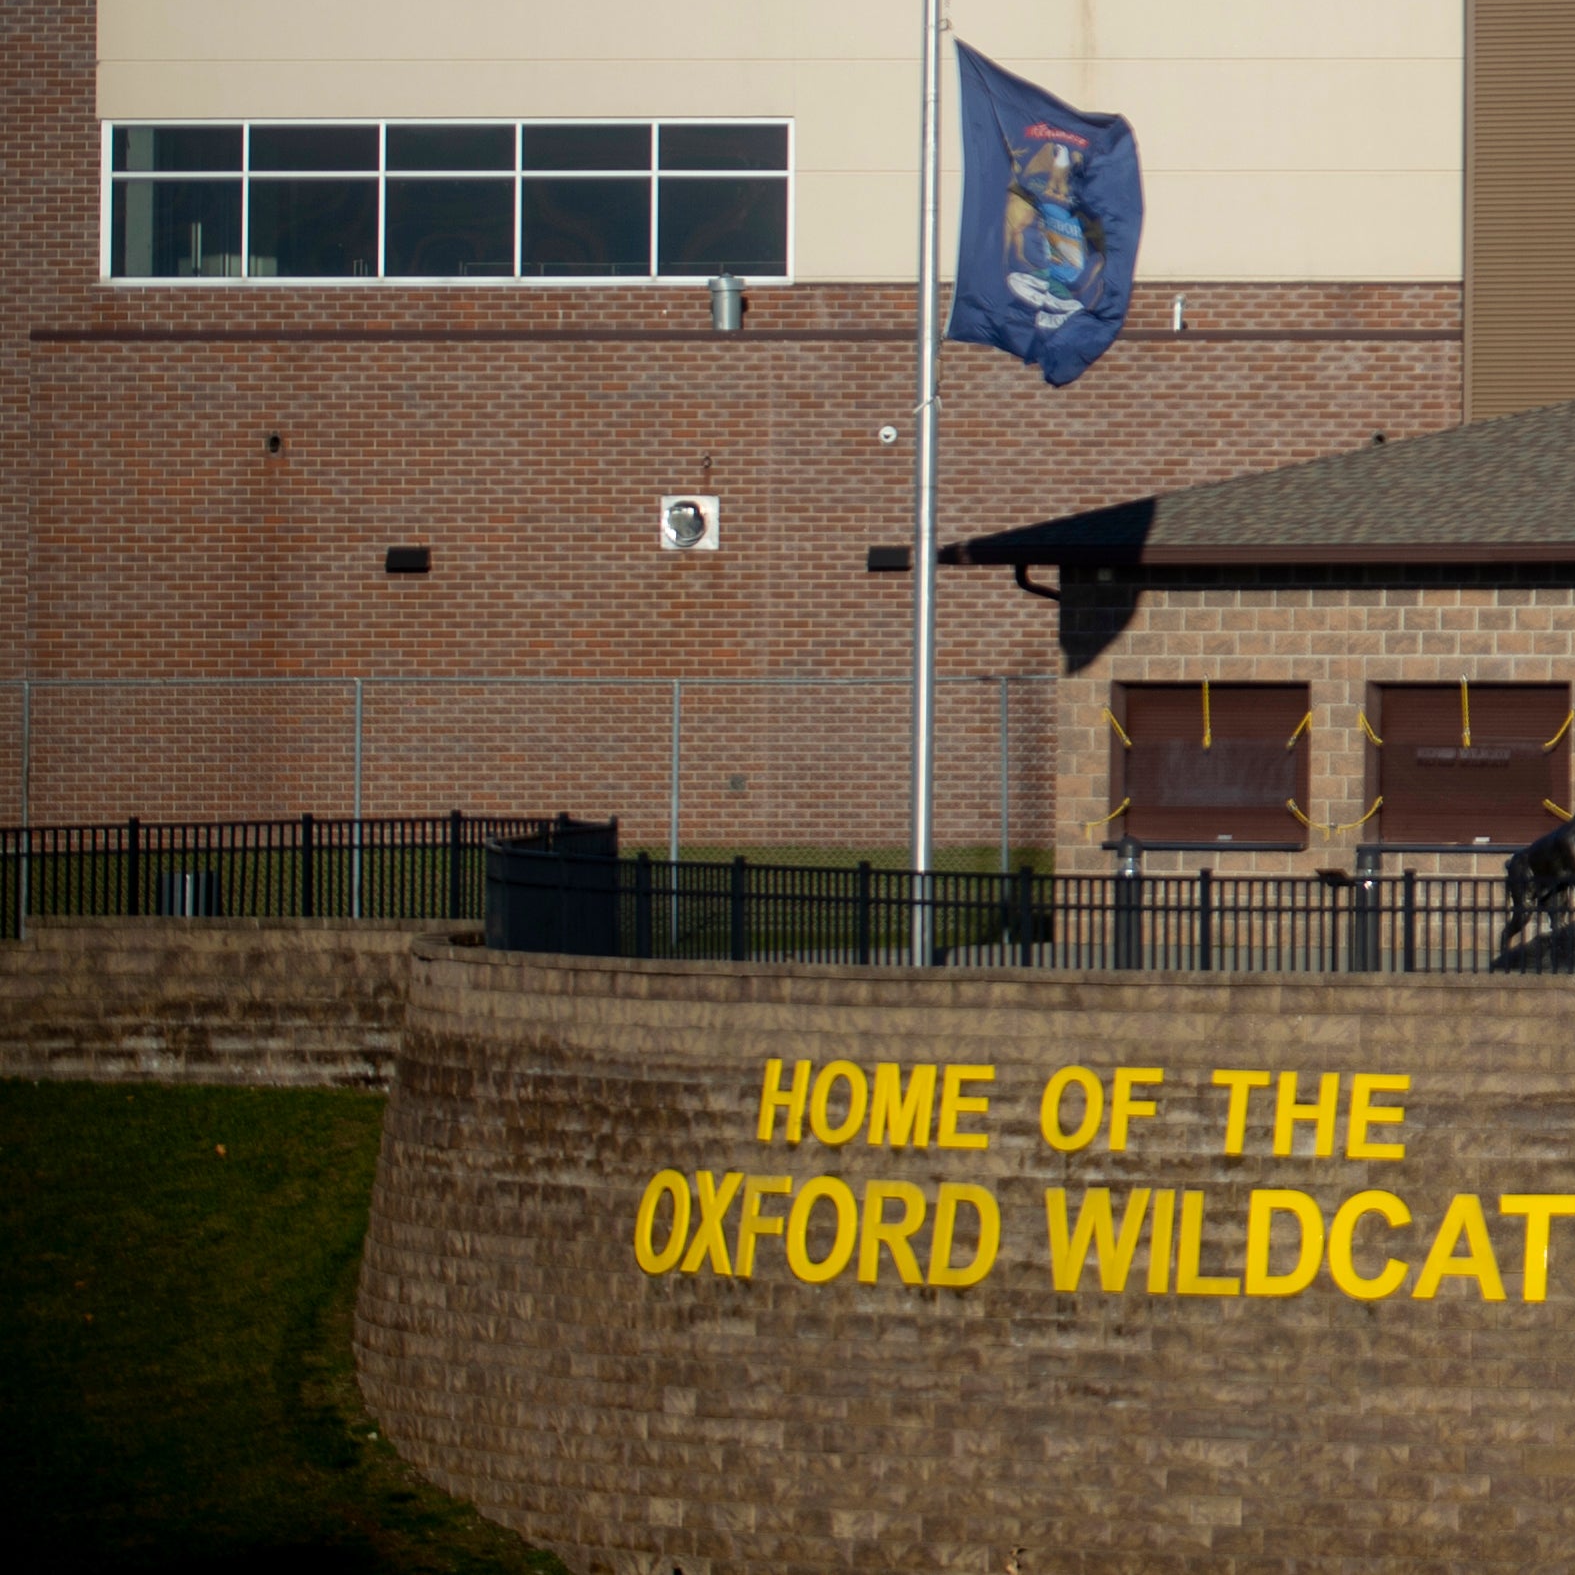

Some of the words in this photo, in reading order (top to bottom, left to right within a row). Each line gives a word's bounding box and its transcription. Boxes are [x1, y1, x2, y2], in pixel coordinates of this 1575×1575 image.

[756, 1057, 996, 1152] HOME
[1038, 1064, 1165, 1153] OF
[1210, 1067, 1411, 1162] THE
[633, 1168, 1002, 1288] OXFORD
